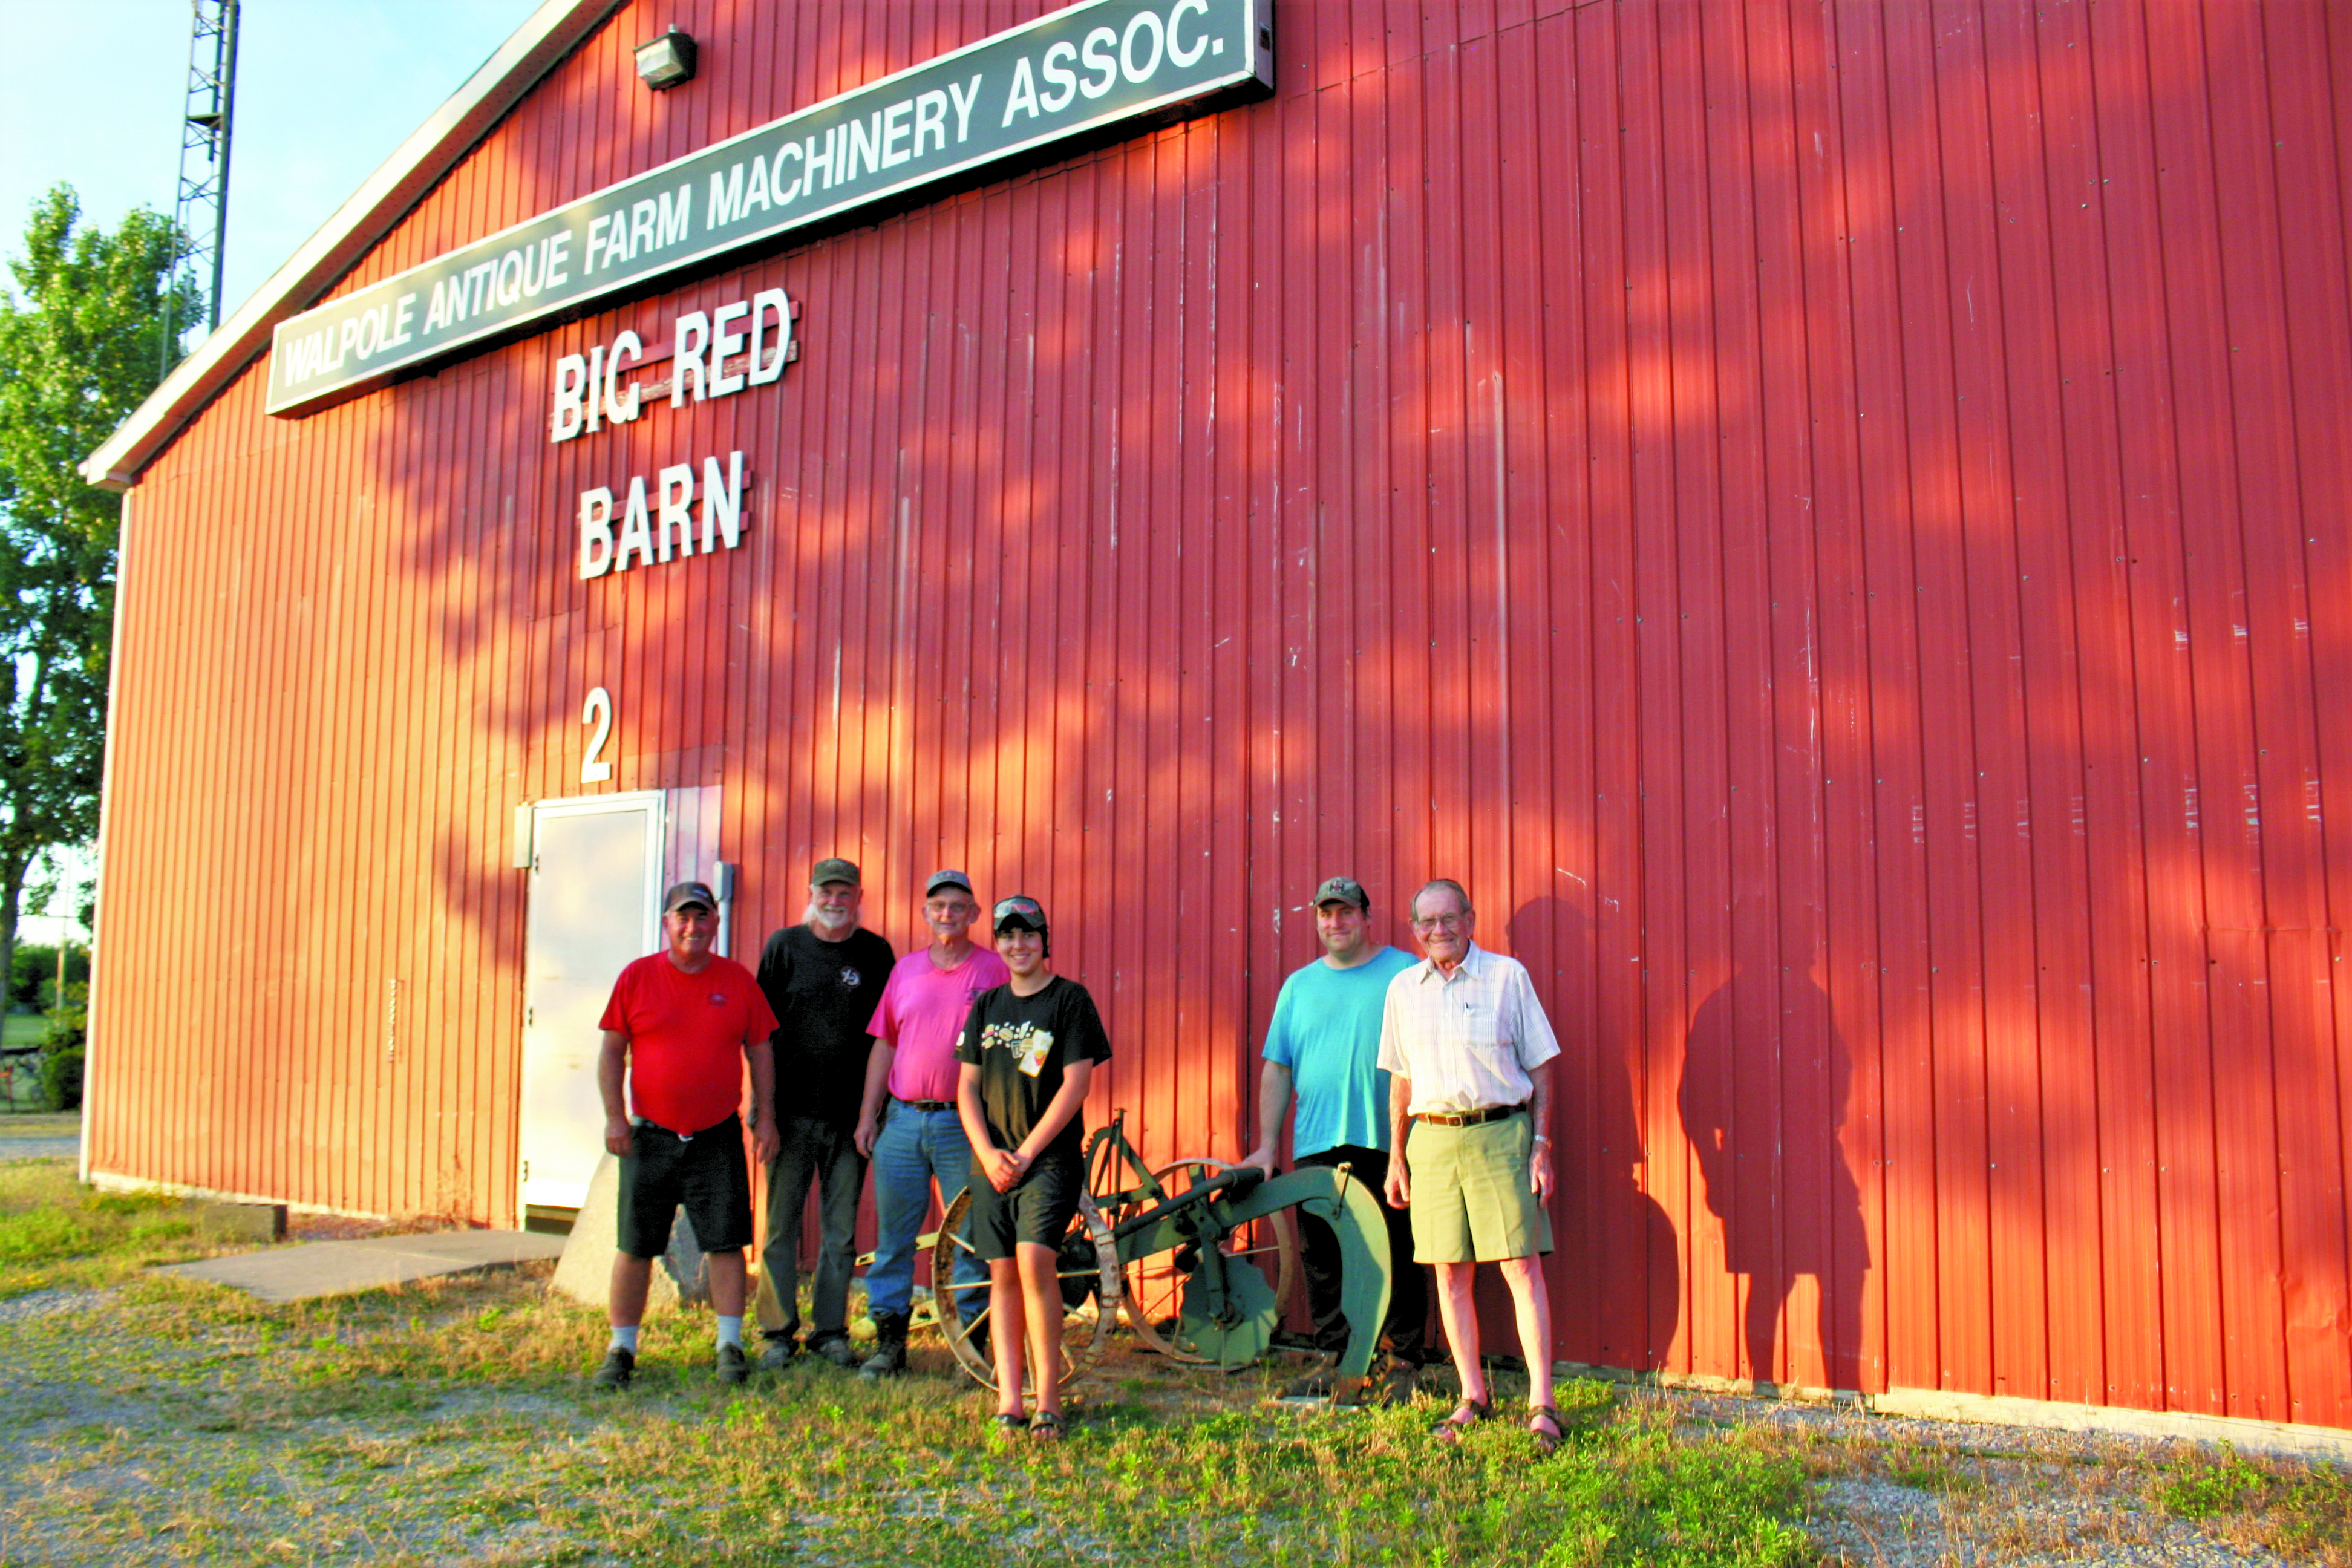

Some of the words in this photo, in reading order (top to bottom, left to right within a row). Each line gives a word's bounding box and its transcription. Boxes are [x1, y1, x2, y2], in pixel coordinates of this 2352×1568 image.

[284, 293, 416, 388] WALPOLE
[423, 229, 572, 335] ANTIQUE
[583, 183, 691, 274] FARM
[706, 73, 982, 230] MACHINERY
[1002, 0, 1223, 128] ASSOC.
[551, 330, 642, 443] BIG
[671, 287, 792, 409] RED
[579, 451, 743, 580] BARN
[581, 687, 612, 784] 2
